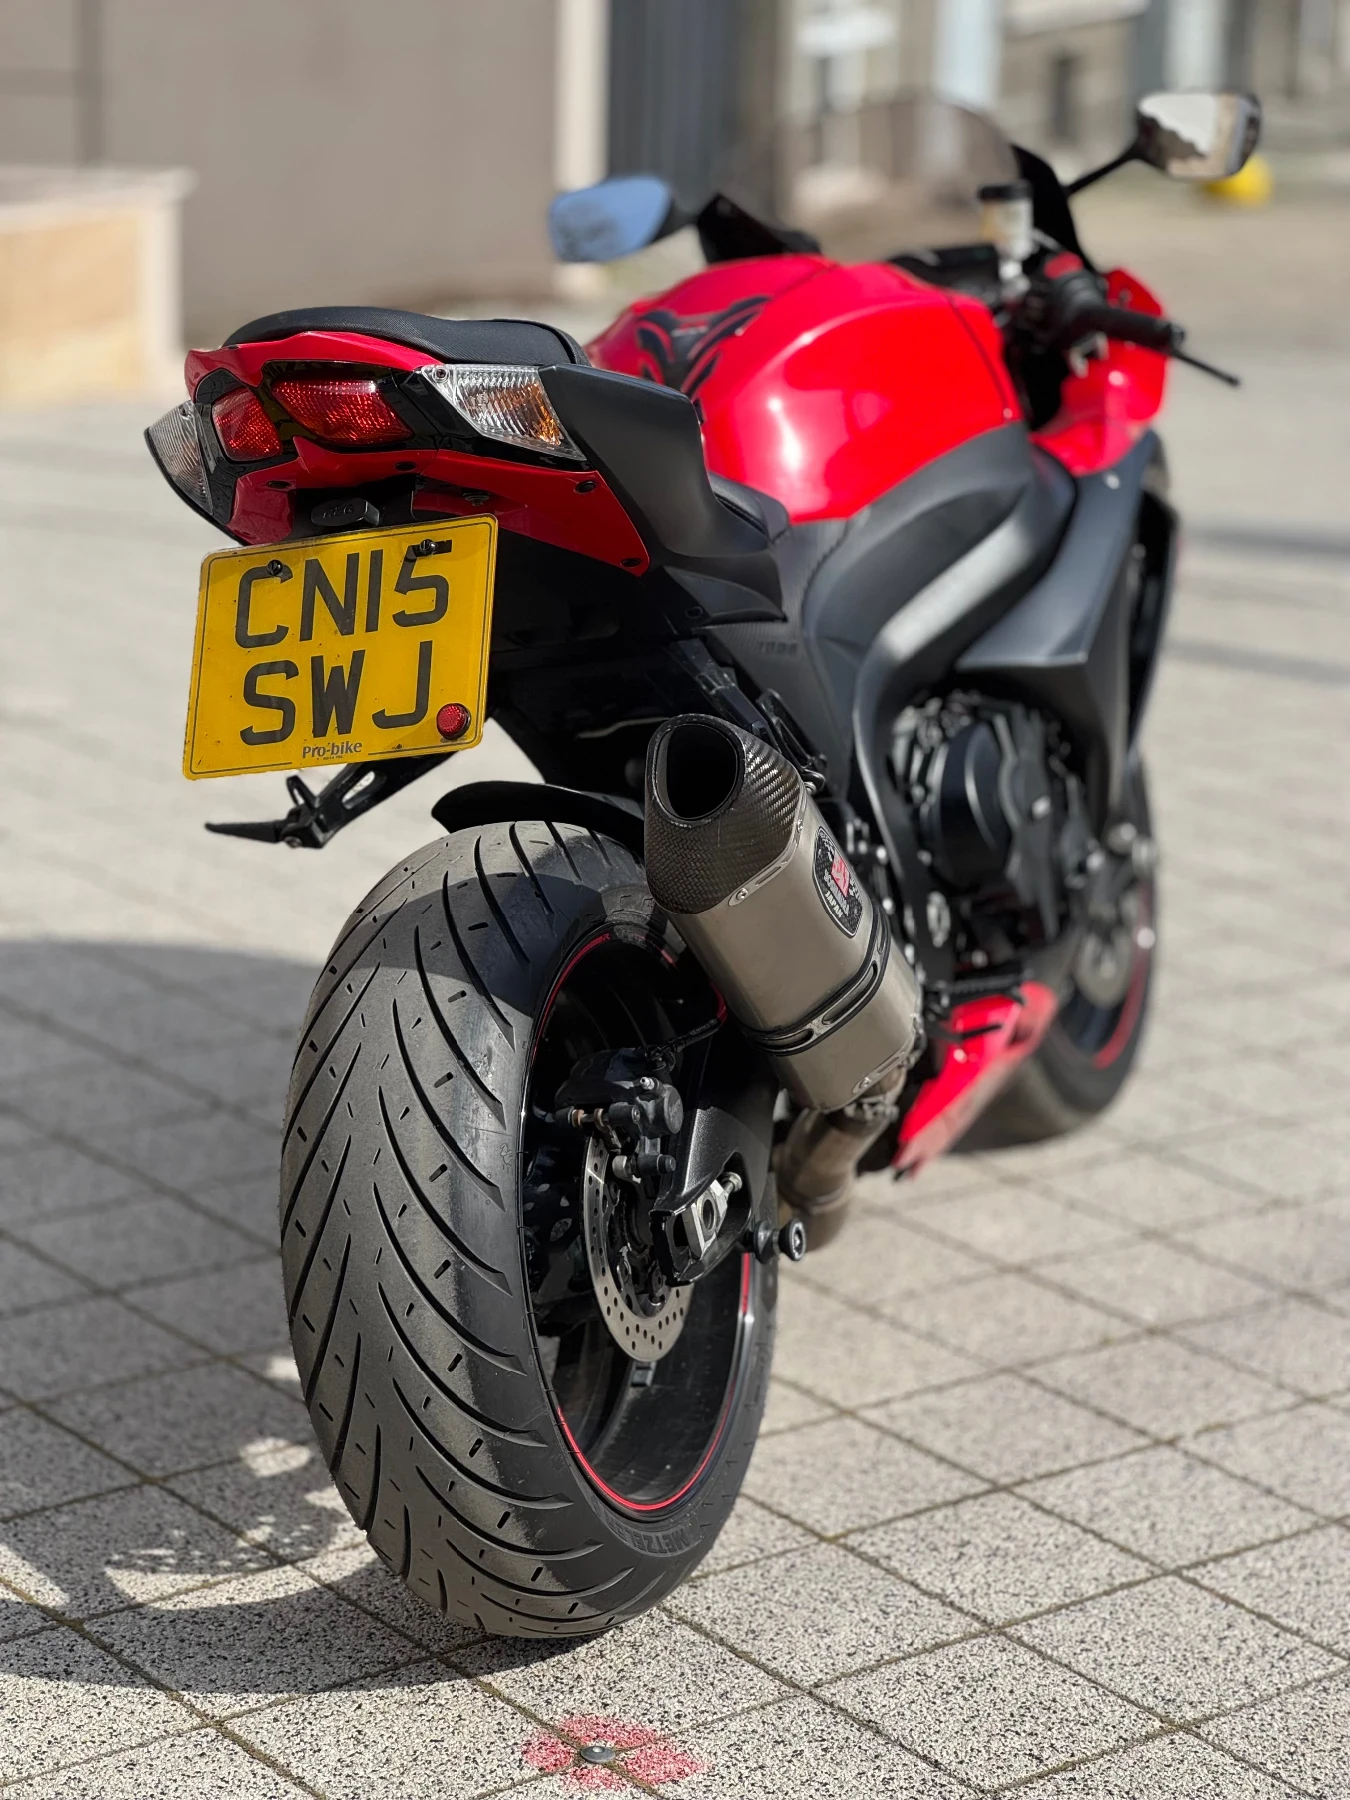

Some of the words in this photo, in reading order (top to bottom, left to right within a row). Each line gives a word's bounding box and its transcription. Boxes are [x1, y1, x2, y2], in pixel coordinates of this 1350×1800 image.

[235, 539, 452, 649] CN15
[240, 640, 433, 746] SWJ
[302, 740, 363, 759] Pro-bike
[824, 890, 843, 918] JAPAN
